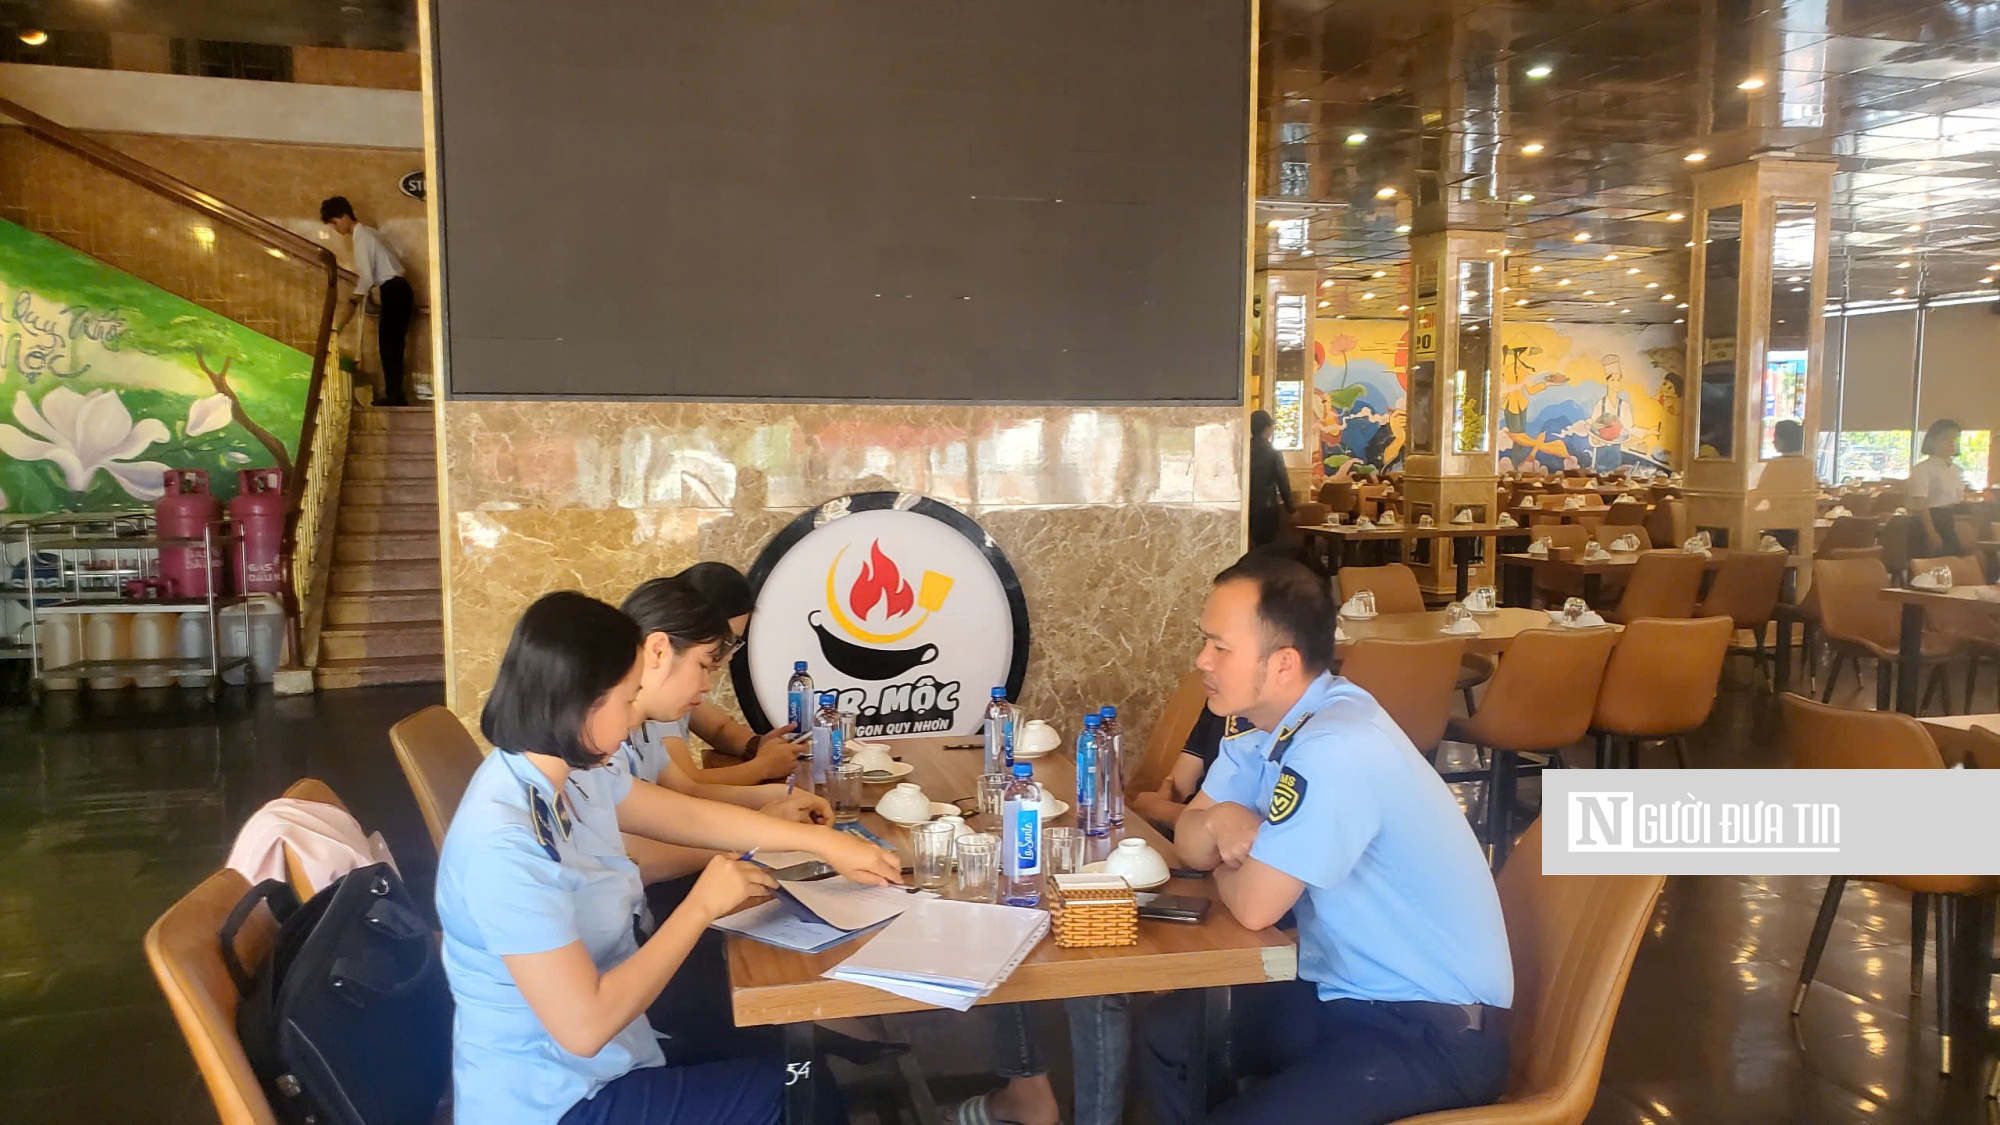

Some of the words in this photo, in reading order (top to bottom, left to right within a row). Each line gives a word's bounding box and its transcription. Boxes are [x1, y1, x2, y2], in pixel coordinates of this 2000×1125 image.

[880, 676, 960, 717] MỘC
[855, 724, 884, 738] GON
[886, 722, 912, 734] QUY
[785, 1061, 811, 1085] 54
